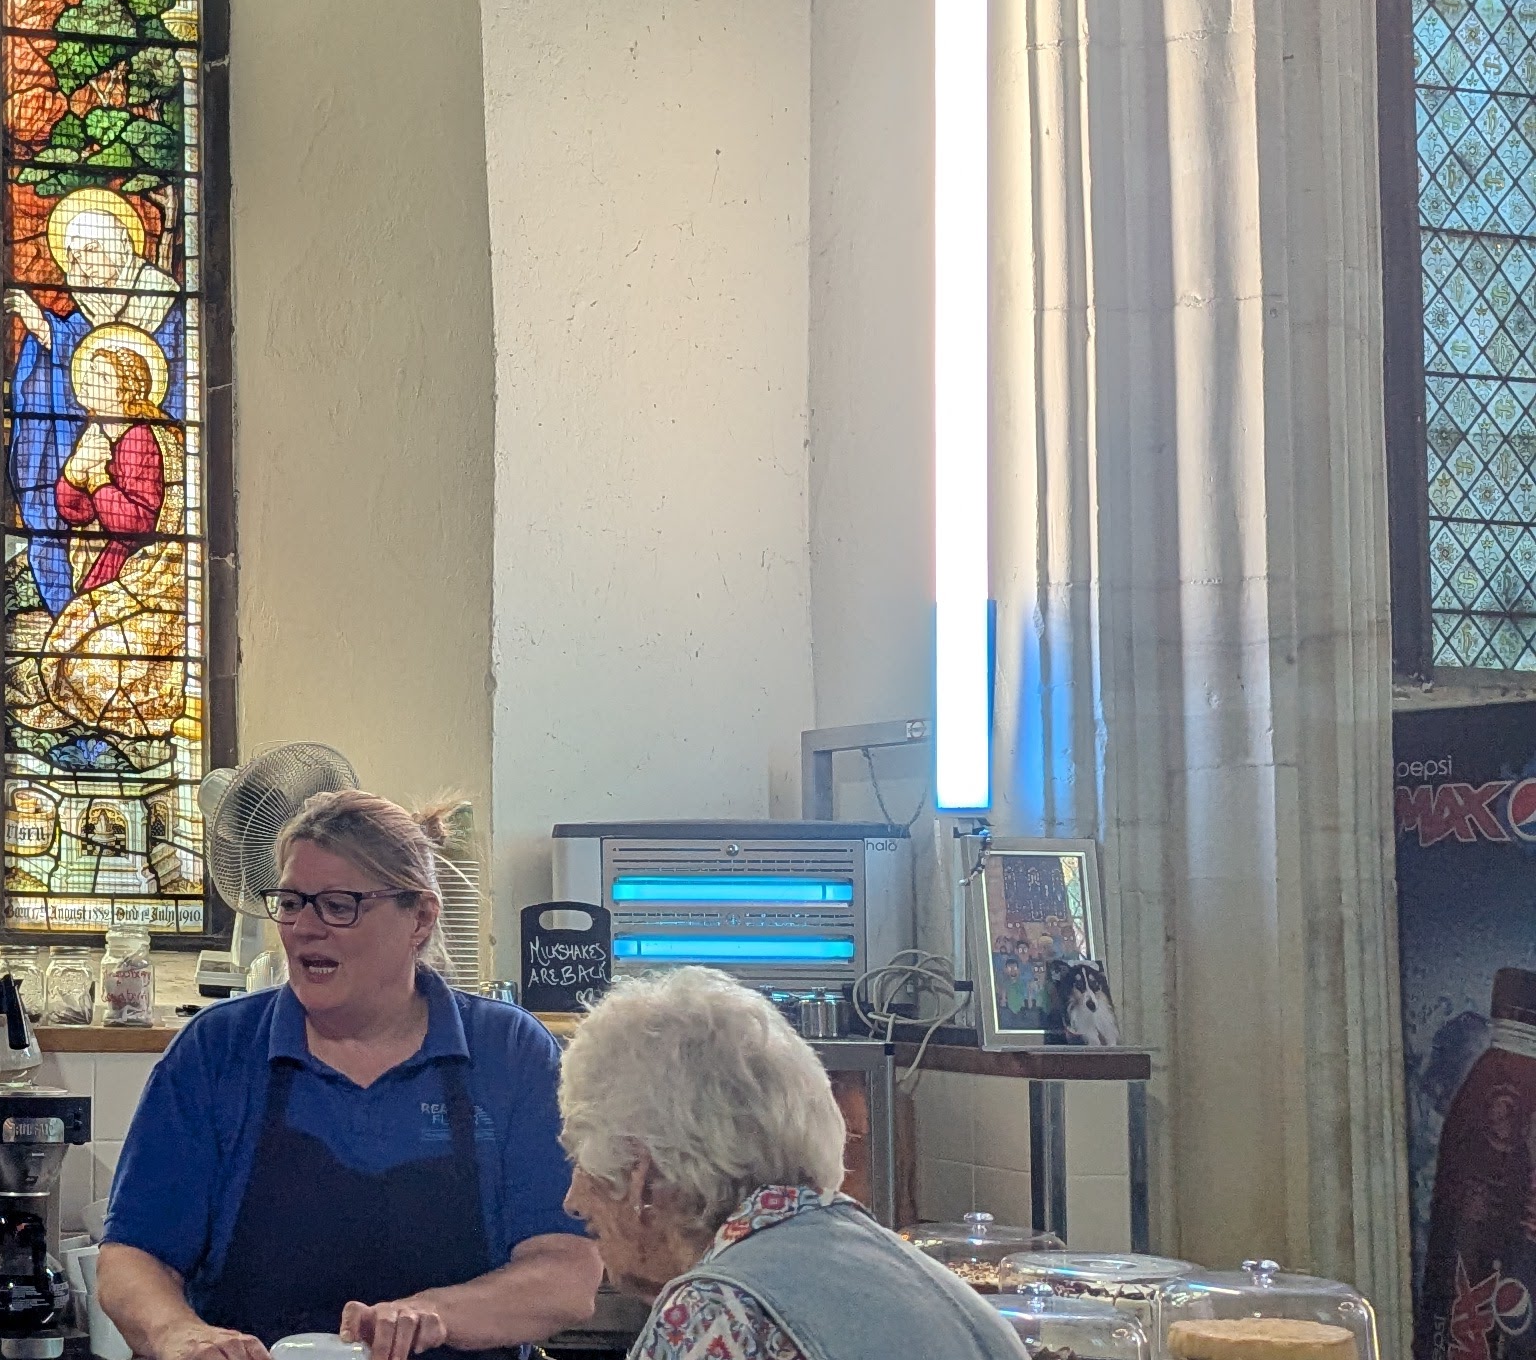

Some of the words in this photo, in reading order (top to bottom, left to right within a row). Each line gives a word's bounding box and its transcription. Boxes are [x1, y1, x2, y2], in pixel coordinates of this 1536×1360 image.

[866, 840, 897, 851] halo
[529, 935, 607, 967] MILKSHAKES
[527, 967, 560, 988] ARE
[559, 961, 612, 986] BACK
